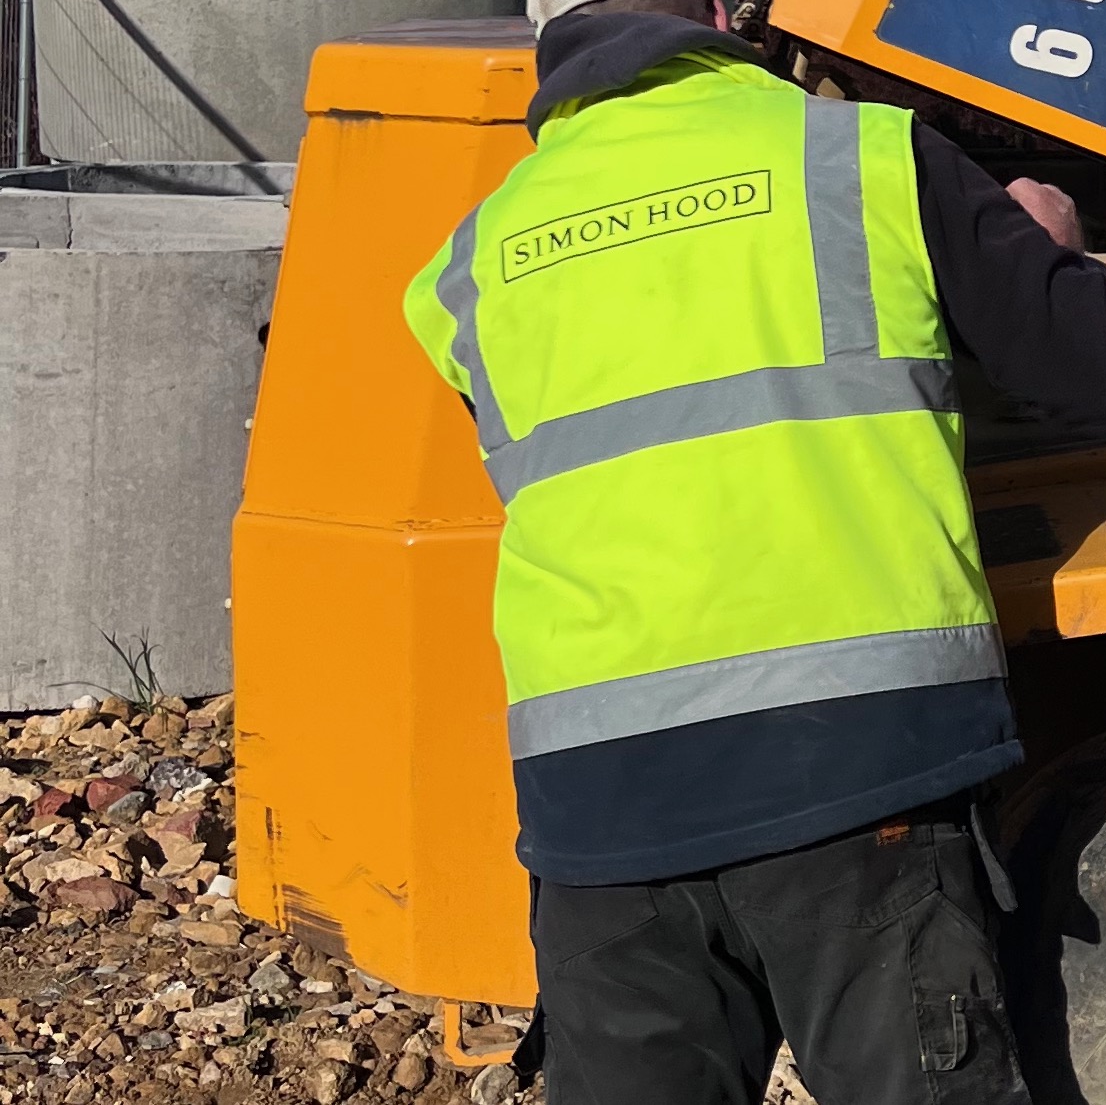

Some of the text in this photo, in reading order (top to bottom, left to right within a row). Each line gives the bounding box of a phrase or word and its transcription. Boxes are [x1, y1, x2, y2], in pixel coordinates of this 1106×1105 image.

[1009, 24, 1093, 78] 6
[514, 183, 756, 265] SIMON HOOD
